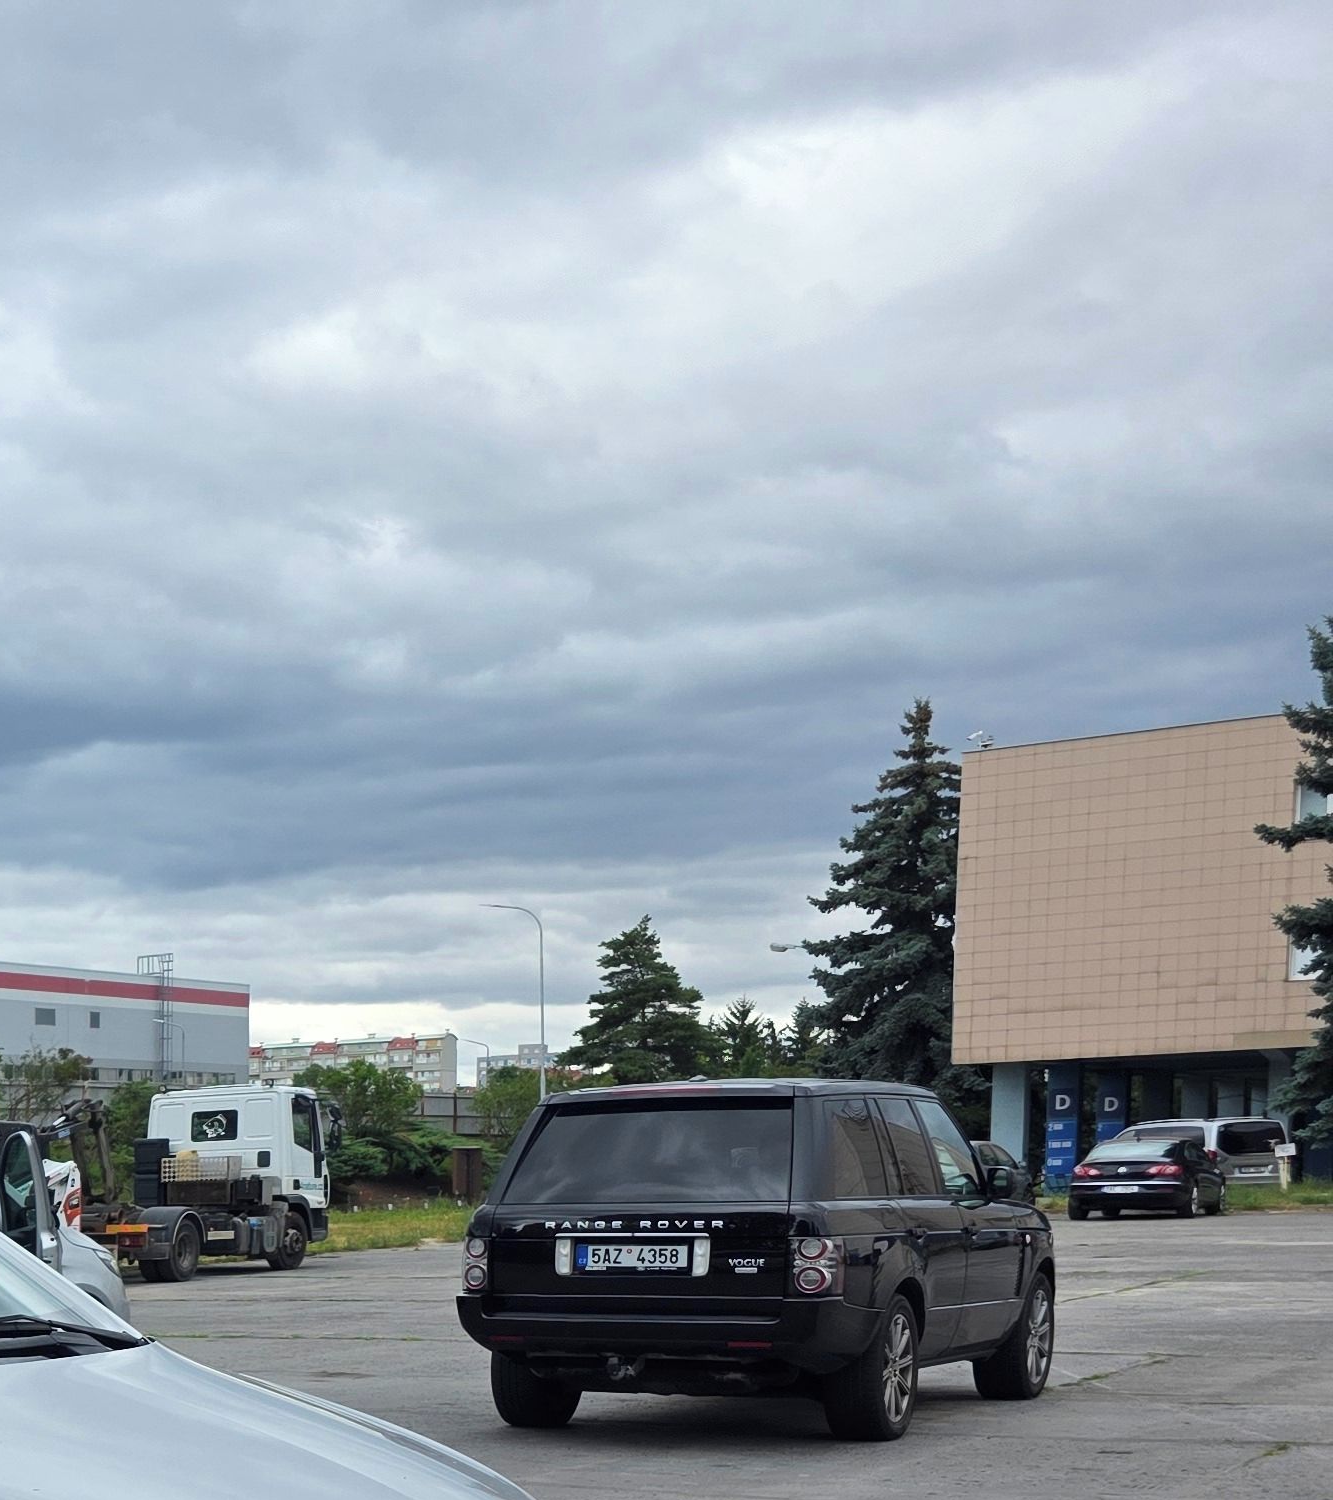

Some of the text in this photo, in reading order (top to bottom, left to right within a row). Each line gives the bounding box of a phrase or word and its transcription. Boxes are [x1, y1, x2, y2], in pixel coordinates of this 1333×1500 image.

[1055, 1094, 1071, 1111] D
[1104, 1096, 1119, 1112] D
[544, 1220, 724, 1229] RANGE ROVER
[591, 1247, 680, 1265] 5AZ 4358
[728, 1258, 766, 1267] VOGUE
